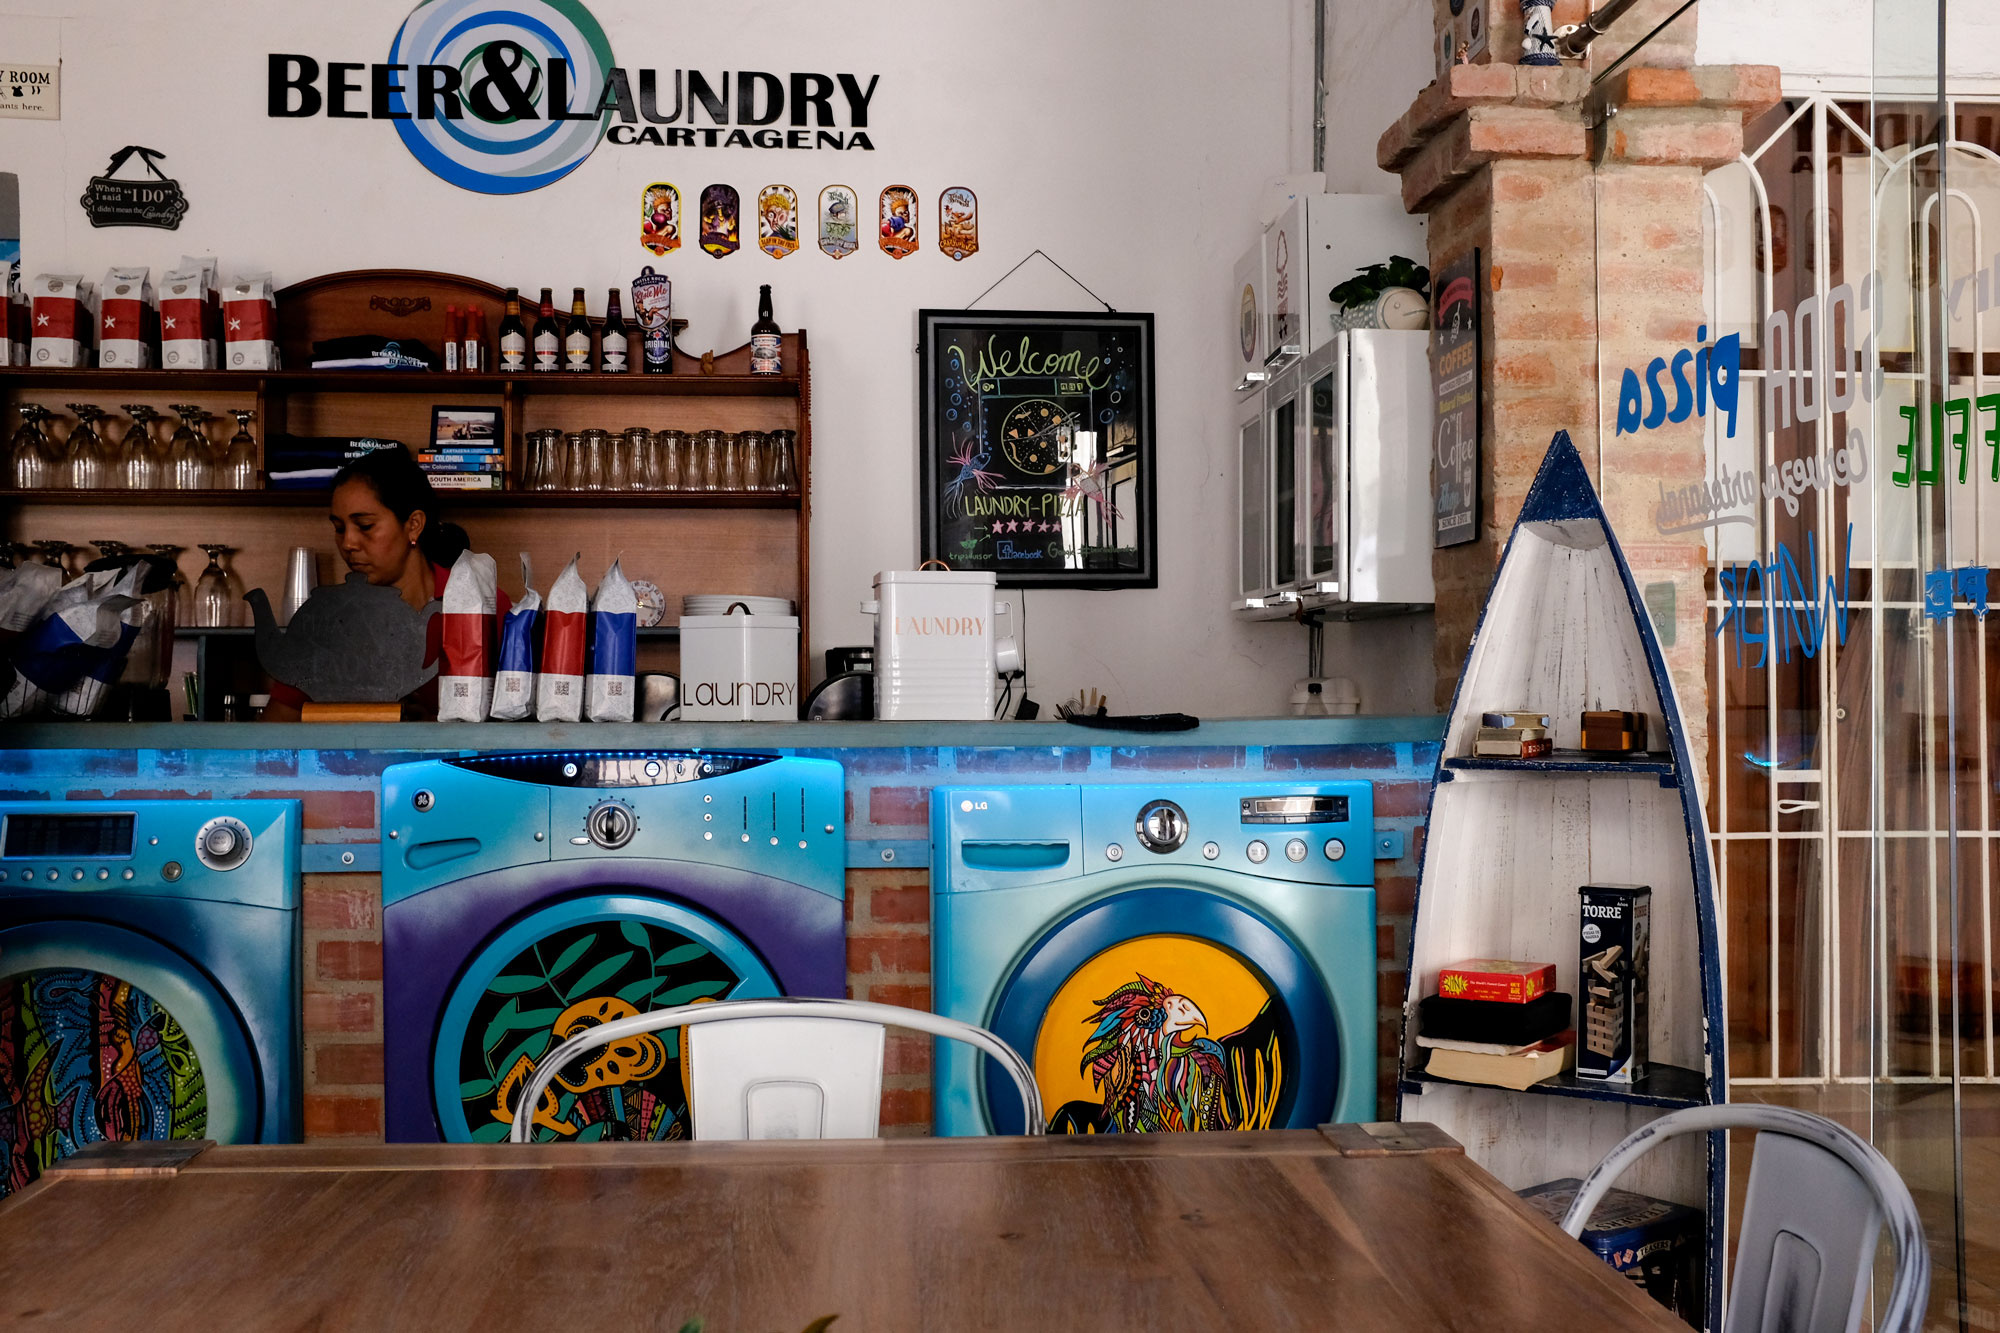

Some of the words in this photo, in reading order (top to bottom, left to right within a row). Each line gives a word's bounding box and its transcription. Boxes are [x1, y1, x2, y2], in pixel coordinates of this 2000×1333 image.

[10, 71, 50, 84] ROOM
[606, 126, 875, 150] CARTAGENA
[94, 185, 121, 193] When
[947, 334, 1112, 390] Welcome
[1440, 340, 1472, 377] COFFEE
[1438, 411, 1473, 483] Coffee
[895, 616, 986, 636] LAUNDRY
[974, 801, 988, 810] LG
[1582, 904, 1622, 919] TORRE
[1597, 1207, 1667, 1231] TEASERS
[1641, 1241, 1669, 1257] TEASERS
